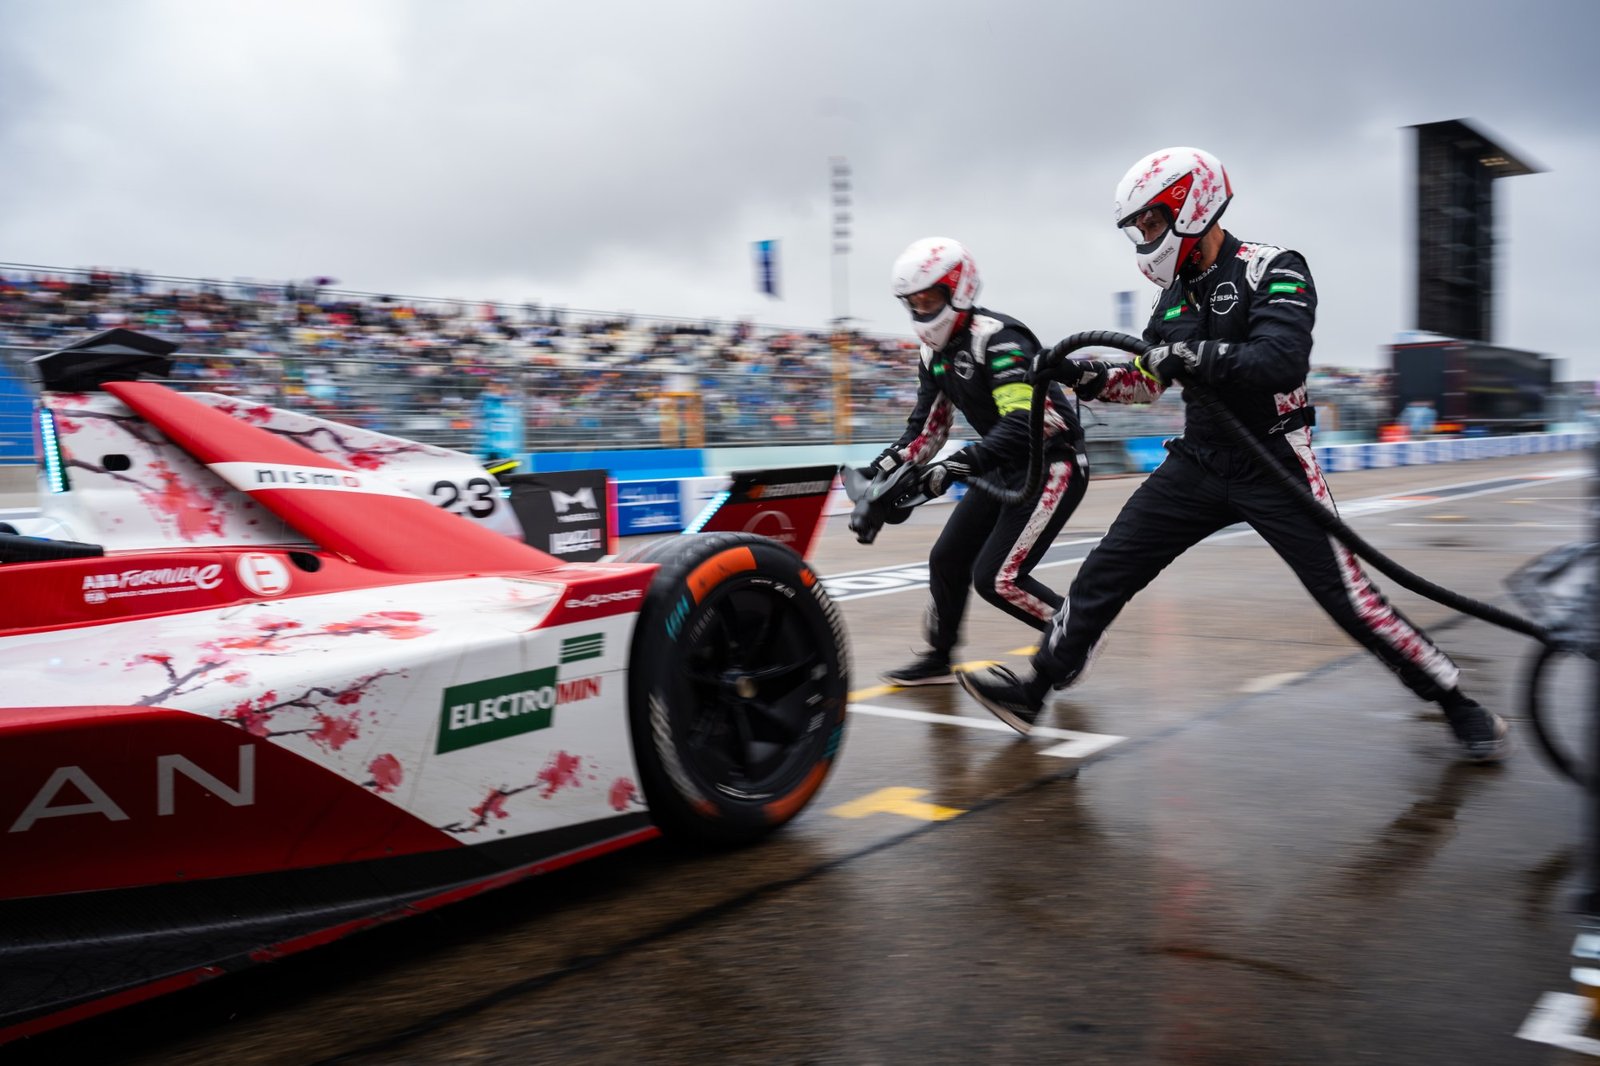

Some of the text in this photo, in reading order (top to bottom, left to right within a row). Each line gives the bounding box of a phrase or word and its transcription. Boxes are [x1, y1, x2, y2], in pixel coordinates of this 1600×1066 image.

[1153, 246, 1175, 264] NISSAN
[1189, 263, 1218, 284] NISSAN
[429, 477, 495, 518] 23
